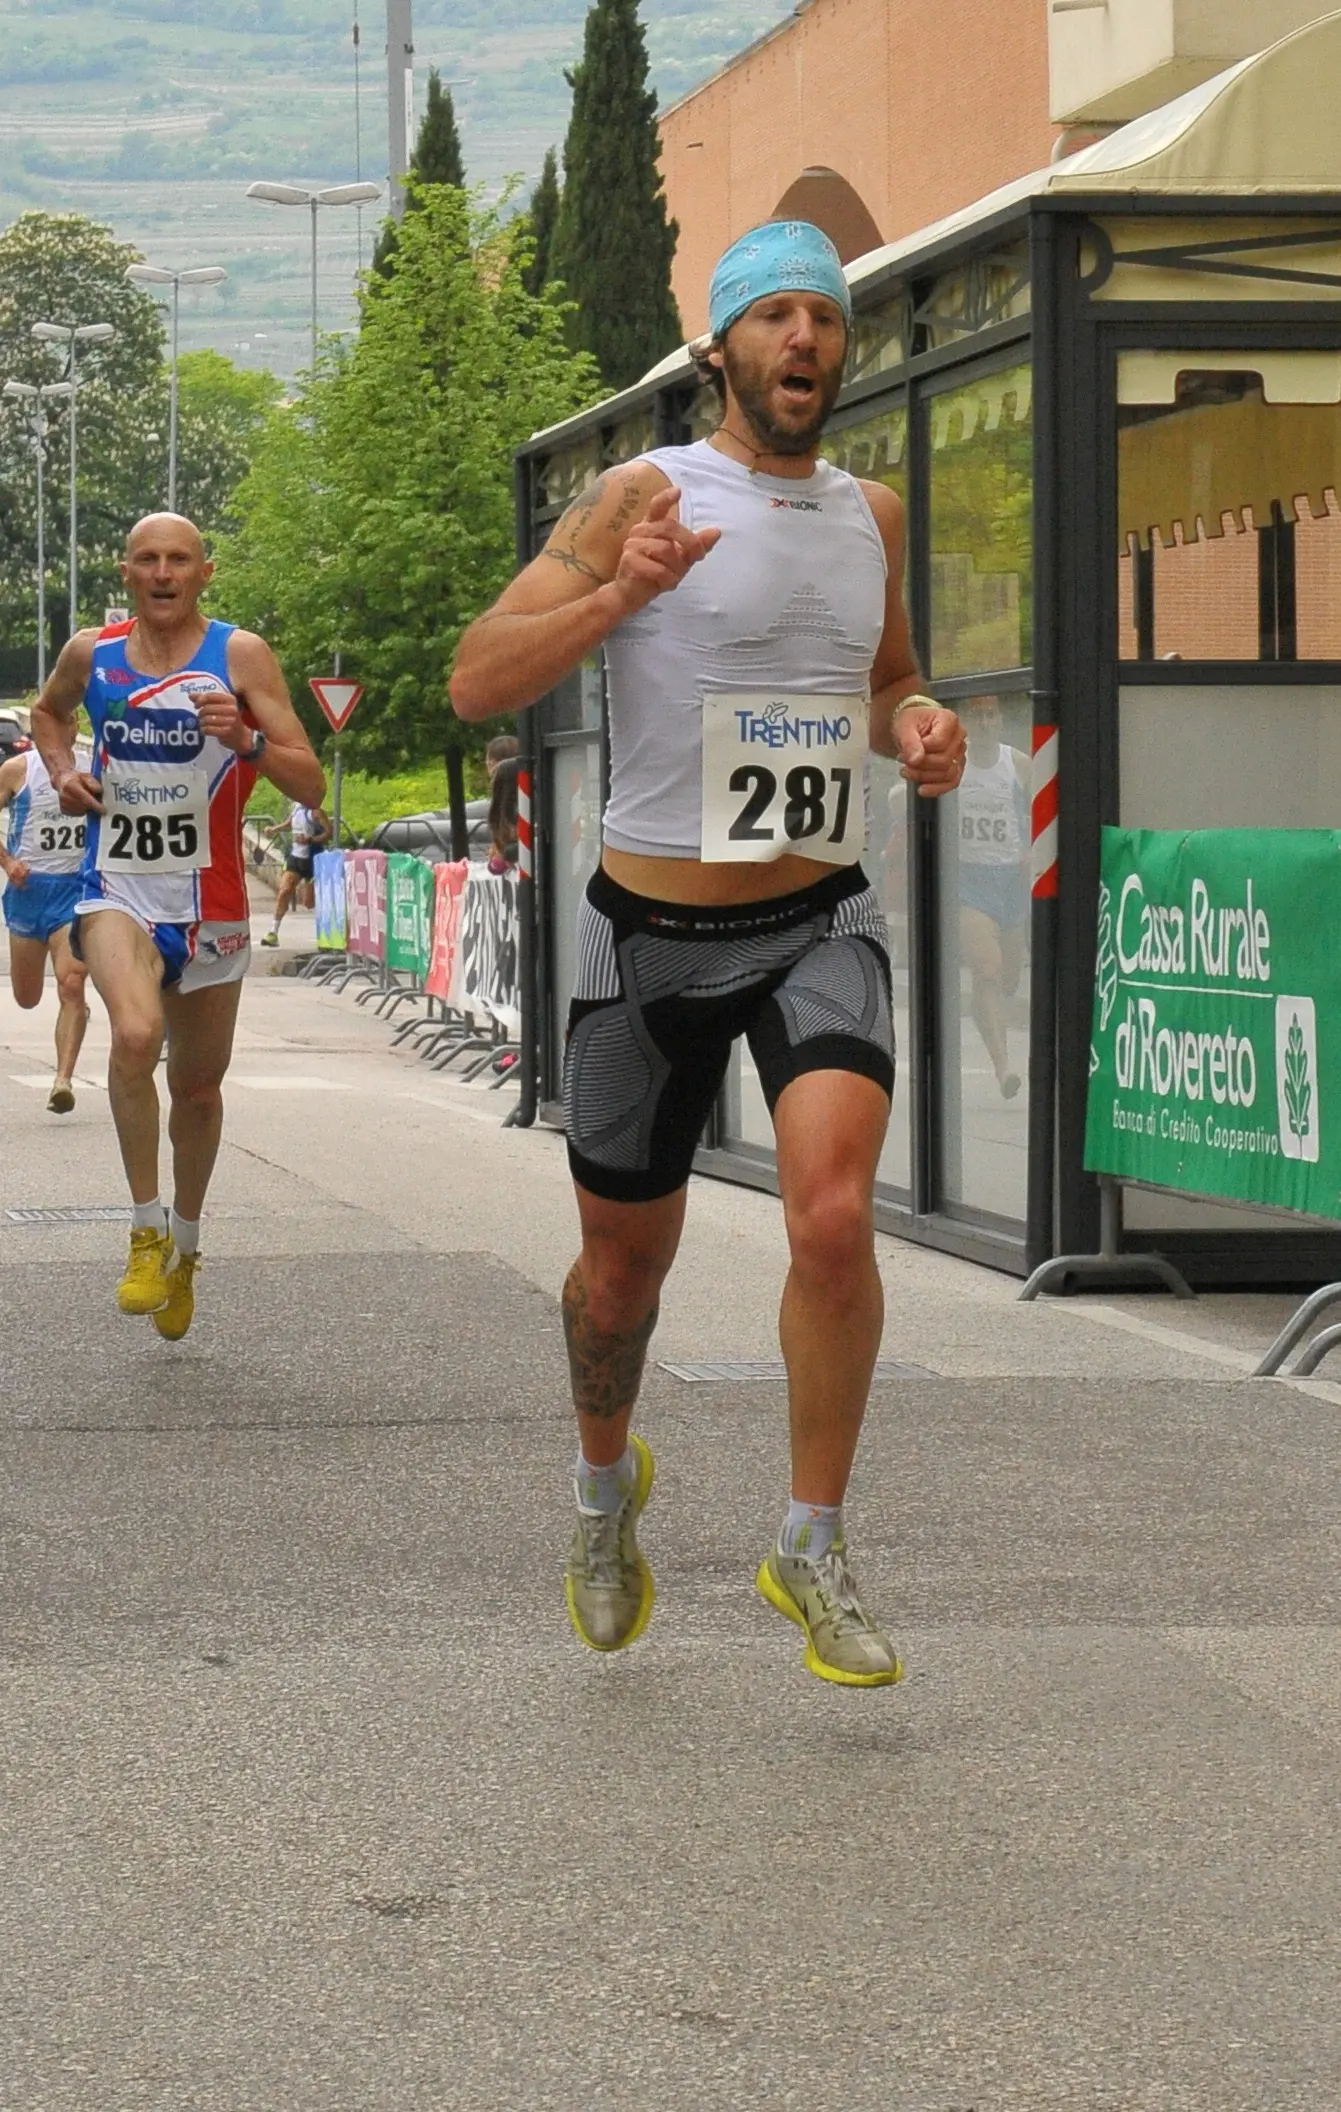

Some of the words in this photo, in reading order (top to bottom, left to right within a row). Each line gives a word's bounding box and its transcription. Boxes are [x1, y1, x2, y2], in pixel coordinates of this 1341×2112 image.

[103, 720, 199, 746] Melinda
[734, 711, 852, 749] TRENTINO
[111, 782, 189, 805] TRENTINO
[728, 764, 852, 844] 287
[40, 825, 86, 851] 328
[108, 813, 198, 861] 285
[1116, 873, 1186, 974] Cassa
[1191, 878, 1270, 981] Rurale
[1115, 996, 1136, 1089] di
[1138, 998, 1256, 1107] Rovereto
[1113, 1099, 1143, 1133] Banca
[1146, 1104, 1156, 1136] di
[1160, 1108, 1200, 1144] Credito
[1205, 1115, 1278, 1158] Cooperativo
